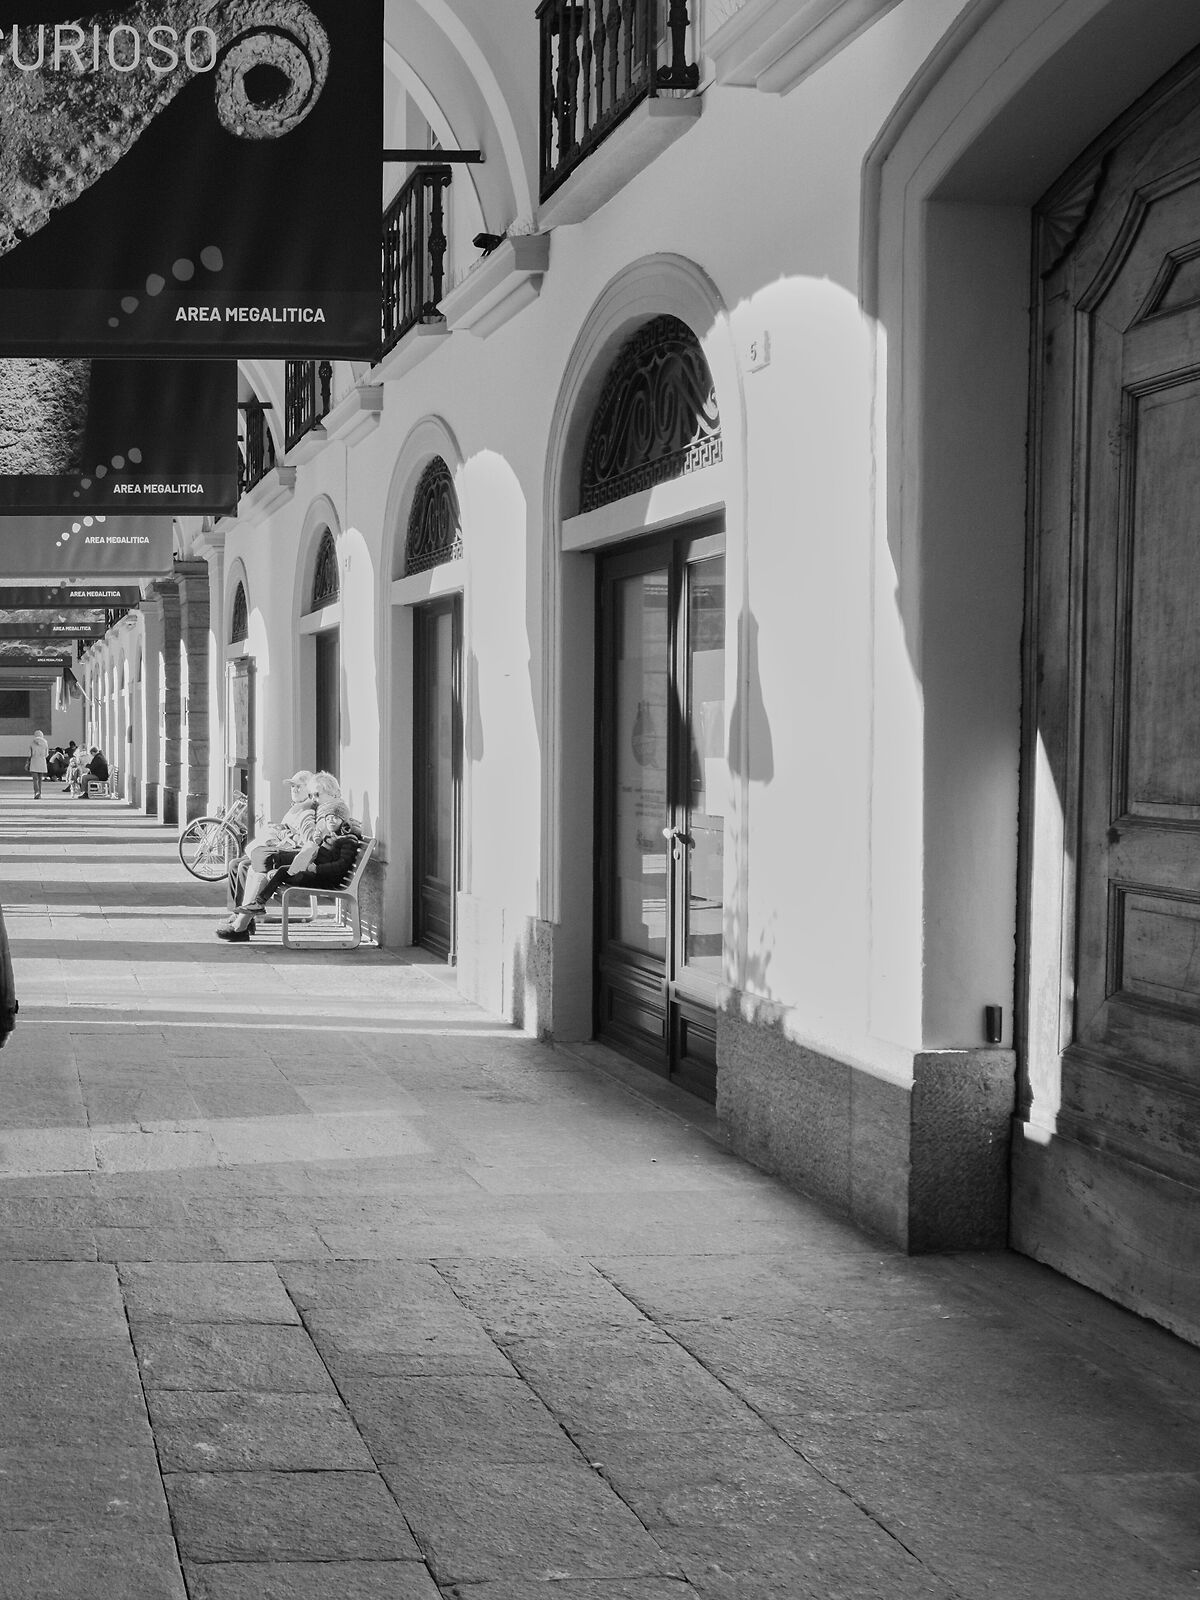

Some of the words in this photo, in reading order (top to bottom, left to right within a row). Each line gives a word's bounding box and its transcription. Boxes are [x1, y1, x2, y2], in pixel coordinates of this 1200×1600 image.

[175, 306, 222, 322] AREA
[225, 307, 326, 323] MEGALITICA
[750, 341, 757, 361] 5
[113, 483, 142, 494] AREA
[143, 483, 204, 494] MEGALITICA
[84, 536, 106, 544] AREA
[106, 536, 150, 544] MEGALITICA
[69, 590, 87, 598] AREA
